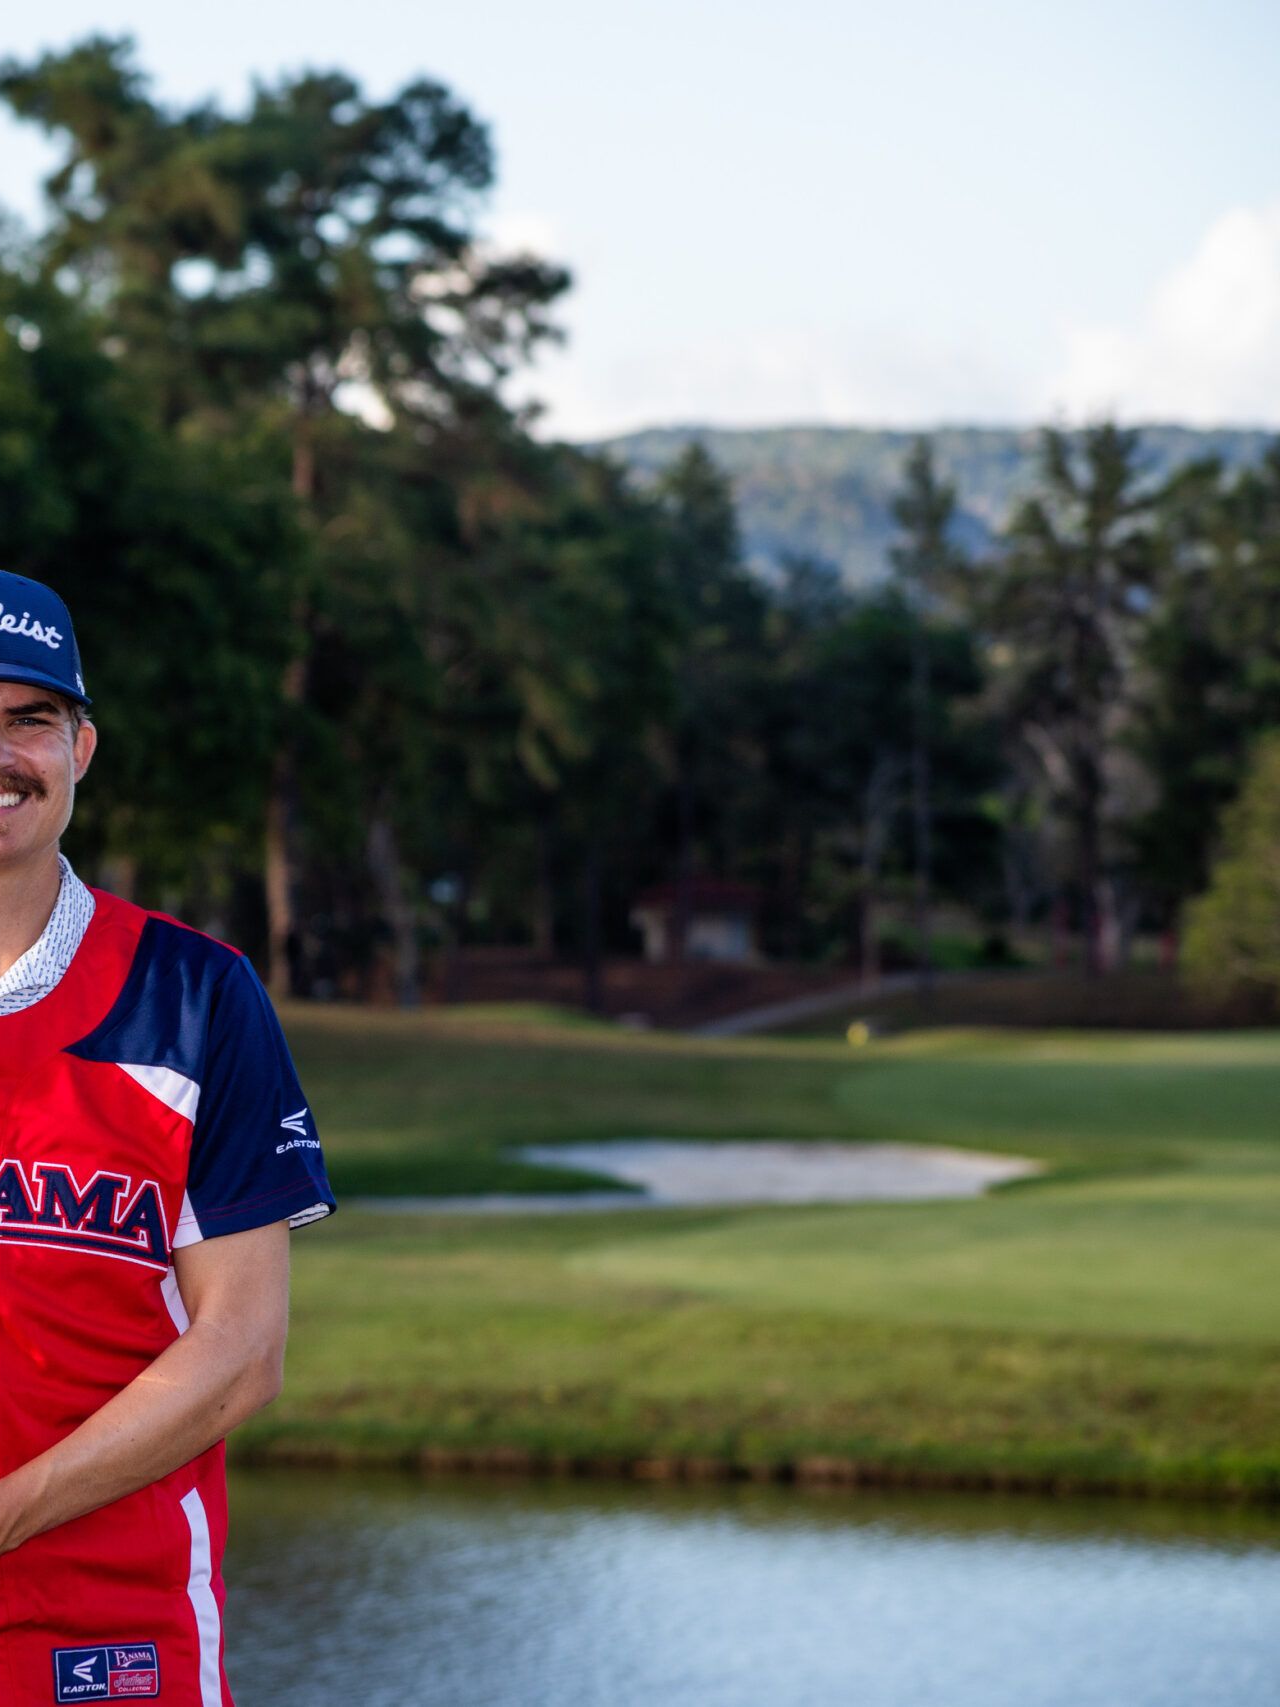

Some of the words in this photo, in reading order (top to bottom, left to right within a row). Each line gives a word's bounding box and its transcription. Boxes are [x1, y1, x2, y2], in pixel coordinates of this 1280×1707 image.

[275, 1139, 321, 1154] EASTON
[114, 1651, 152, 1666] PANAMA
[62, 1683, 106, 1694] EASTON
